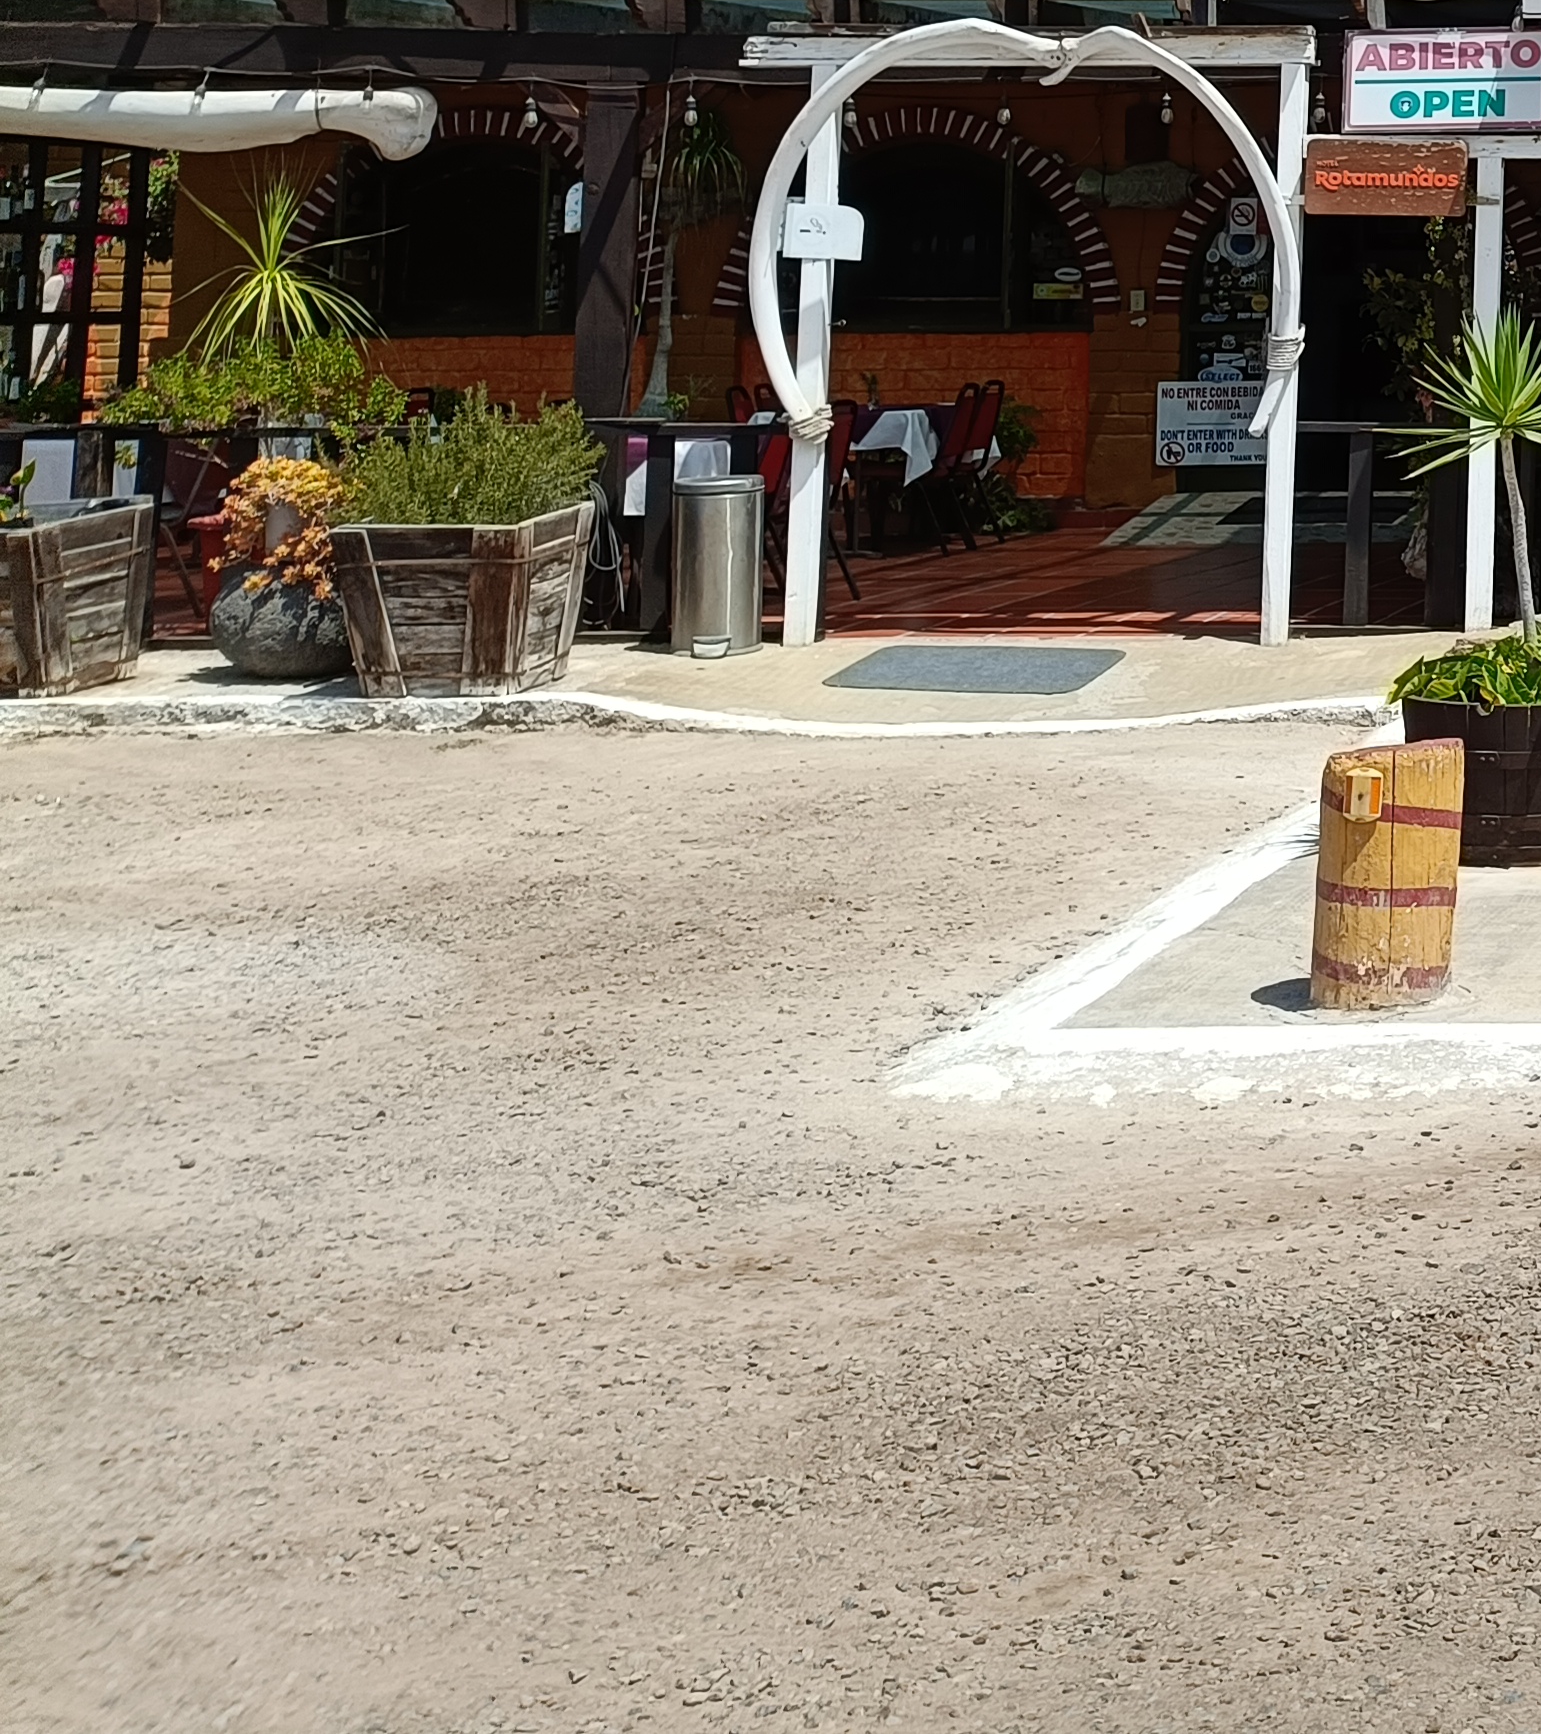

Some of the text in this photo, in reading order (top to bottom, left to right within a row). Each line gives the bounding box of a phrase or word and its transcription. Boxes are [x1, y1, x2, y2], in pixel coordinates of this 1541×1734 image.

[1355, 39, 1541, 72] ABIERTO
[1389, 89, 1506, 119] OPEN
[1314, 168, 1460, 192] Rotamundos
[1161, 387, 1175, 399] NO
[1177, 387, 1208, 398] ENTRE
[1209, 387, 1231, 398] CON
[1187, 399, 1241, 411] NI COMIDA
[1160, 430, 1186, 442] DON'T
[1187, 429, 1215, 441] ENTER
[1216, 429, 1237, 441] WITH
[1187, 441, 1235, 454] OR FOOD
[1230, 454, 1267, 463] THANK YOU
